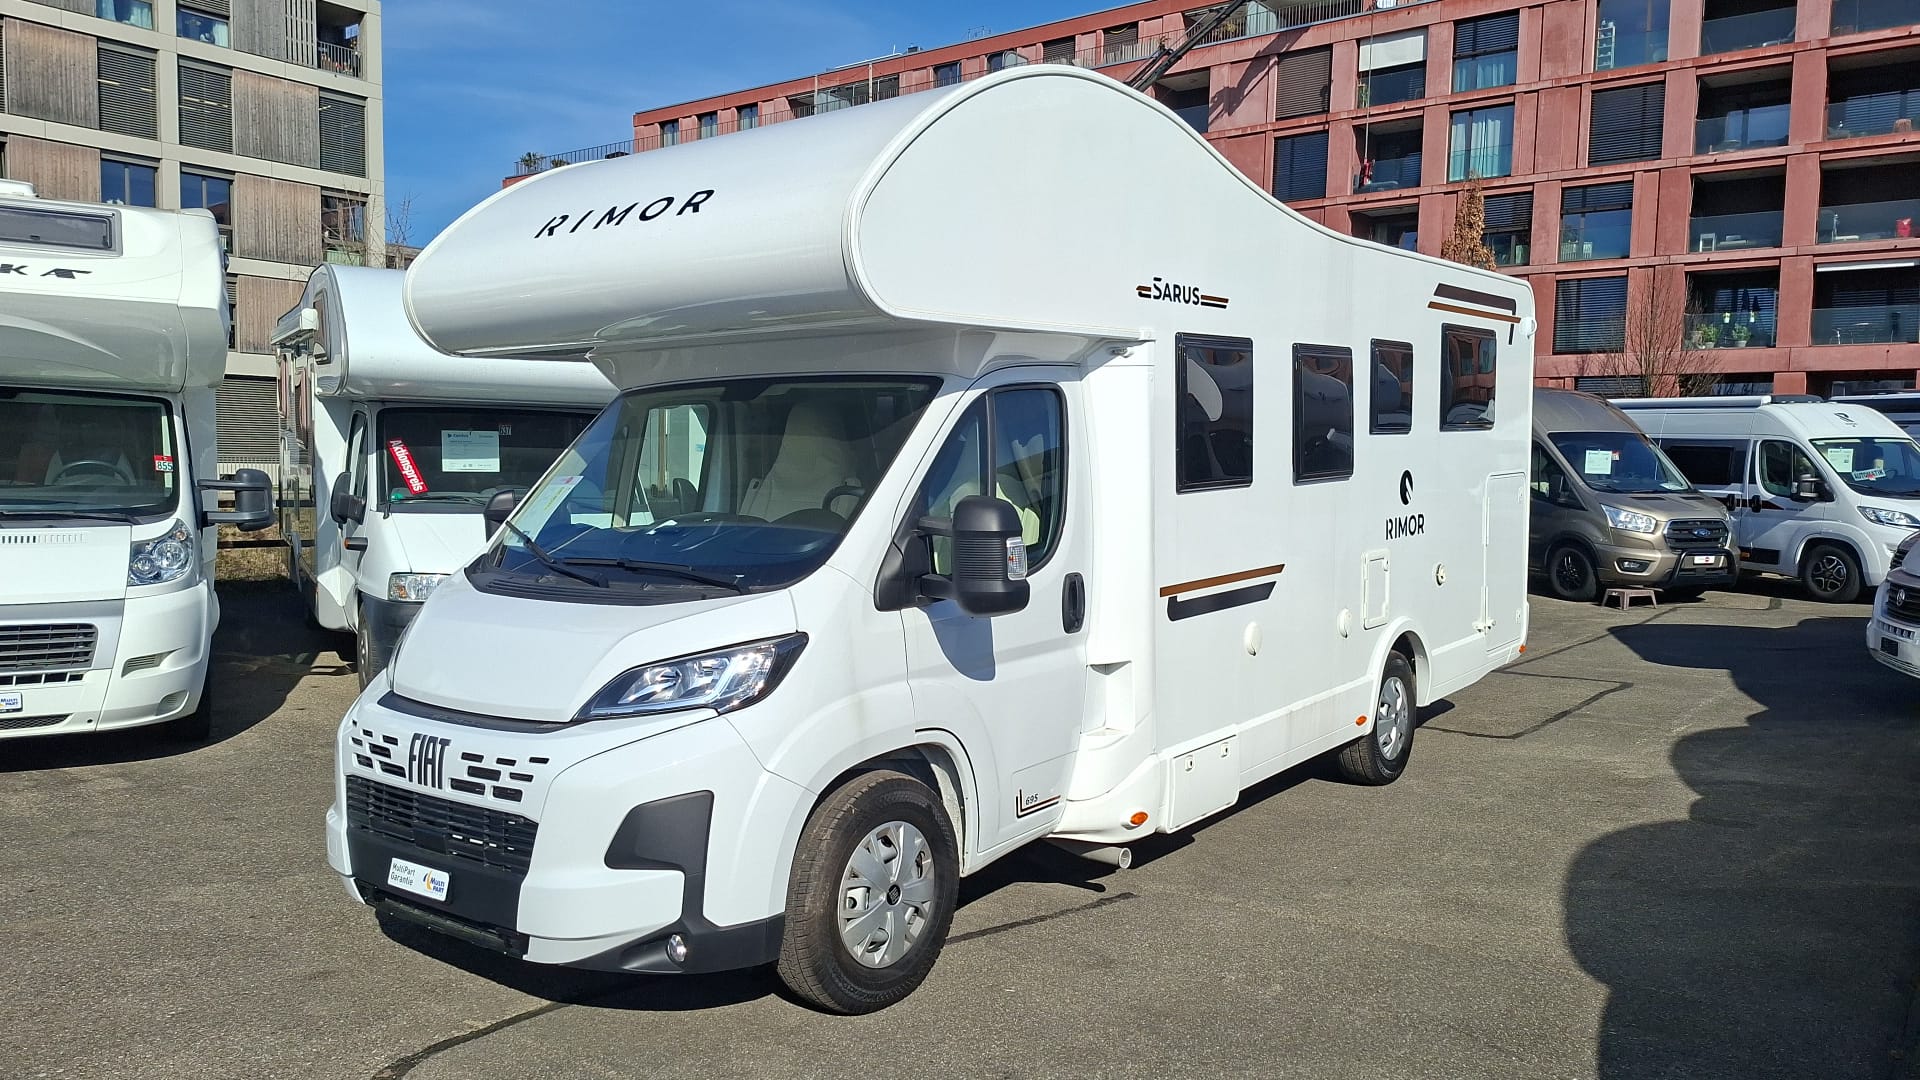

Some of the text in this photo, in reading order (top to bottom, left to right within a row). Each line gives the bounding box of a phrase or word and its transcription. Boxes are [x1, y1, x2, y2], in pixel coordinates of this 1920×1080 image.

[534, 189, 716, 239] RIMOR
[1152, 277, 1200, 306] SARUS
[157, 461, 173, 471] 855
[390, 440, 423, 492] Aktionspreis
[1385, 513, 1425, 541] RIMOR
[408, 732, 452, 790] FIAT
[1025, 793, 1039, 805] 695
[390, 871, 414, 886] Garantie
[392, 862, 416, 877] MultiPart
[432, 885, 444, 894] PART
